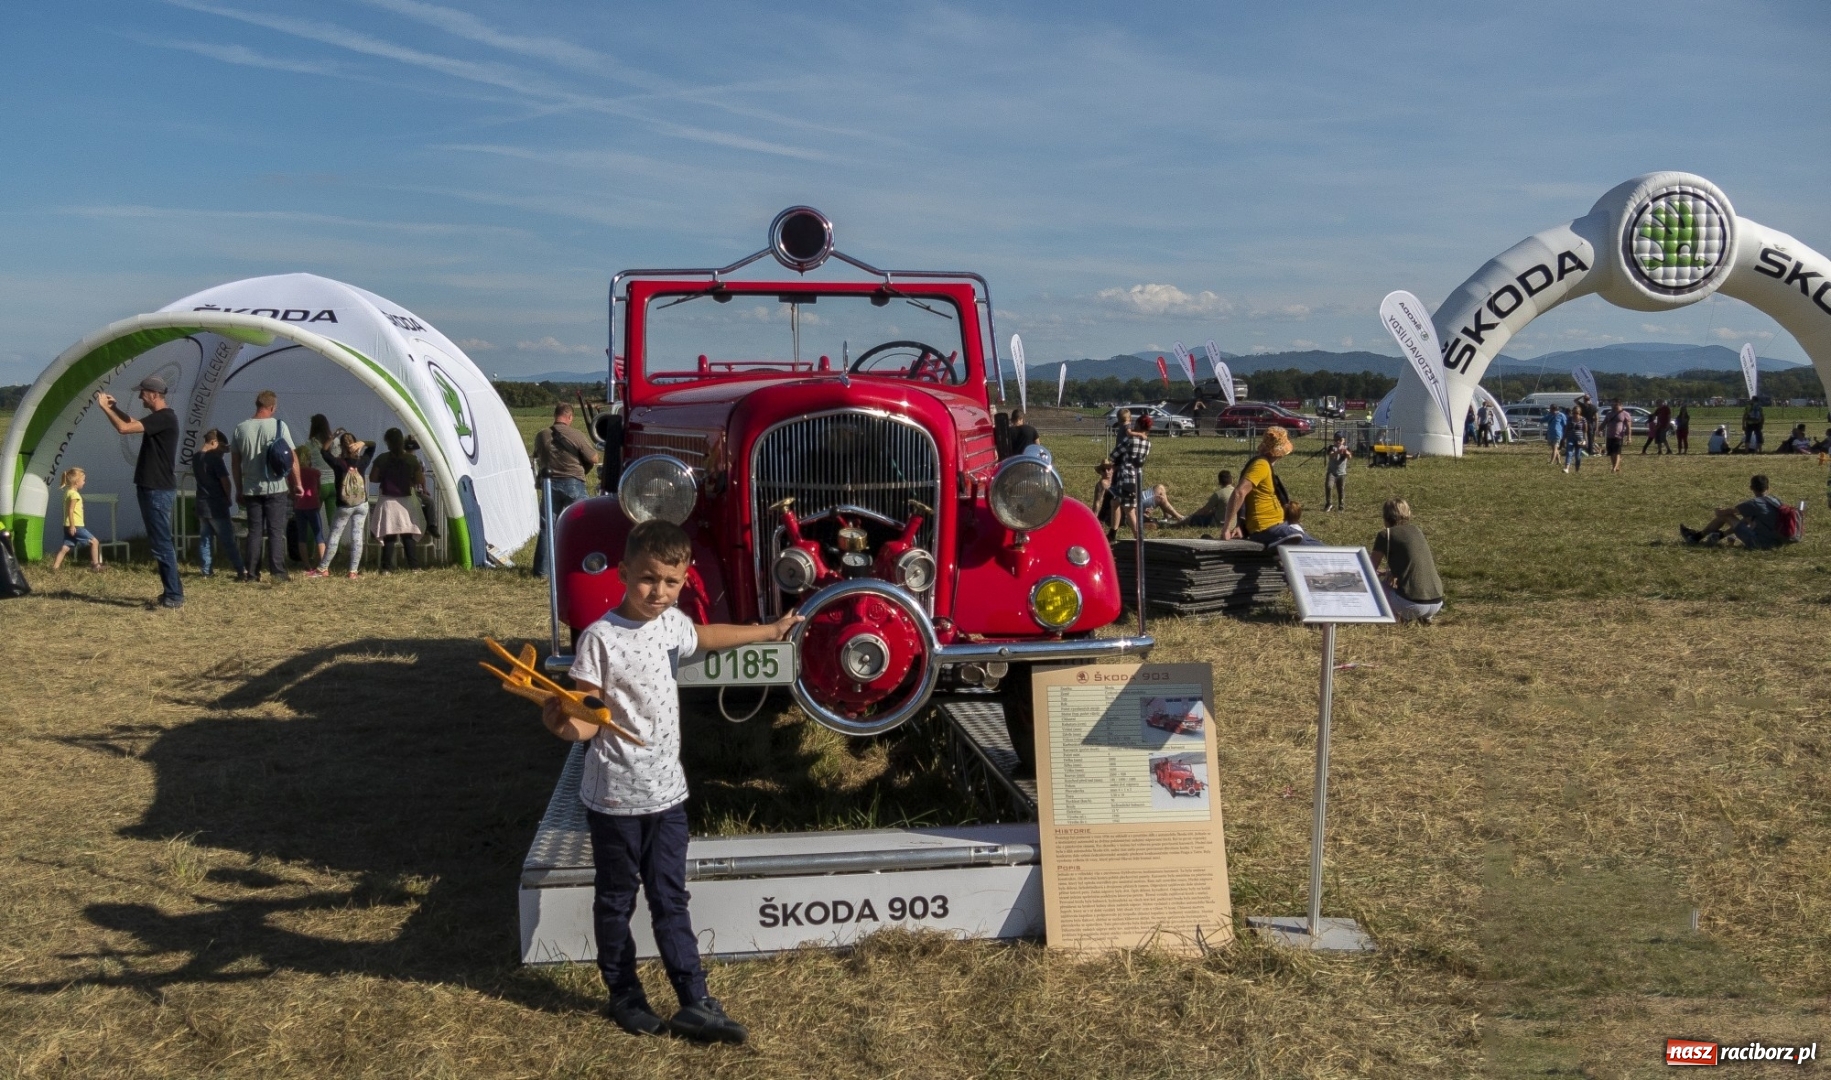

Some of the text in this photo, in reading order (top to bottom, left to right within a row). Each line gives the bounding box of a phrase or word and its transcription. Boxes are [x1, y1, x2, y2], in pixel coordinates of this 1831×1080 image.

[193, 304, 338, 323] ODA
[1441, 250, 1590, 375] ŠKODA
[188, 384, 212, 427] SIMPLY
[204, 341, 232, 385] CLEVER
[704, 648, 779, 680] 0185
[1094, 671, 1170, 682] ŠKODA 903
[758, 895, 949, 928] ŠKODA 903
